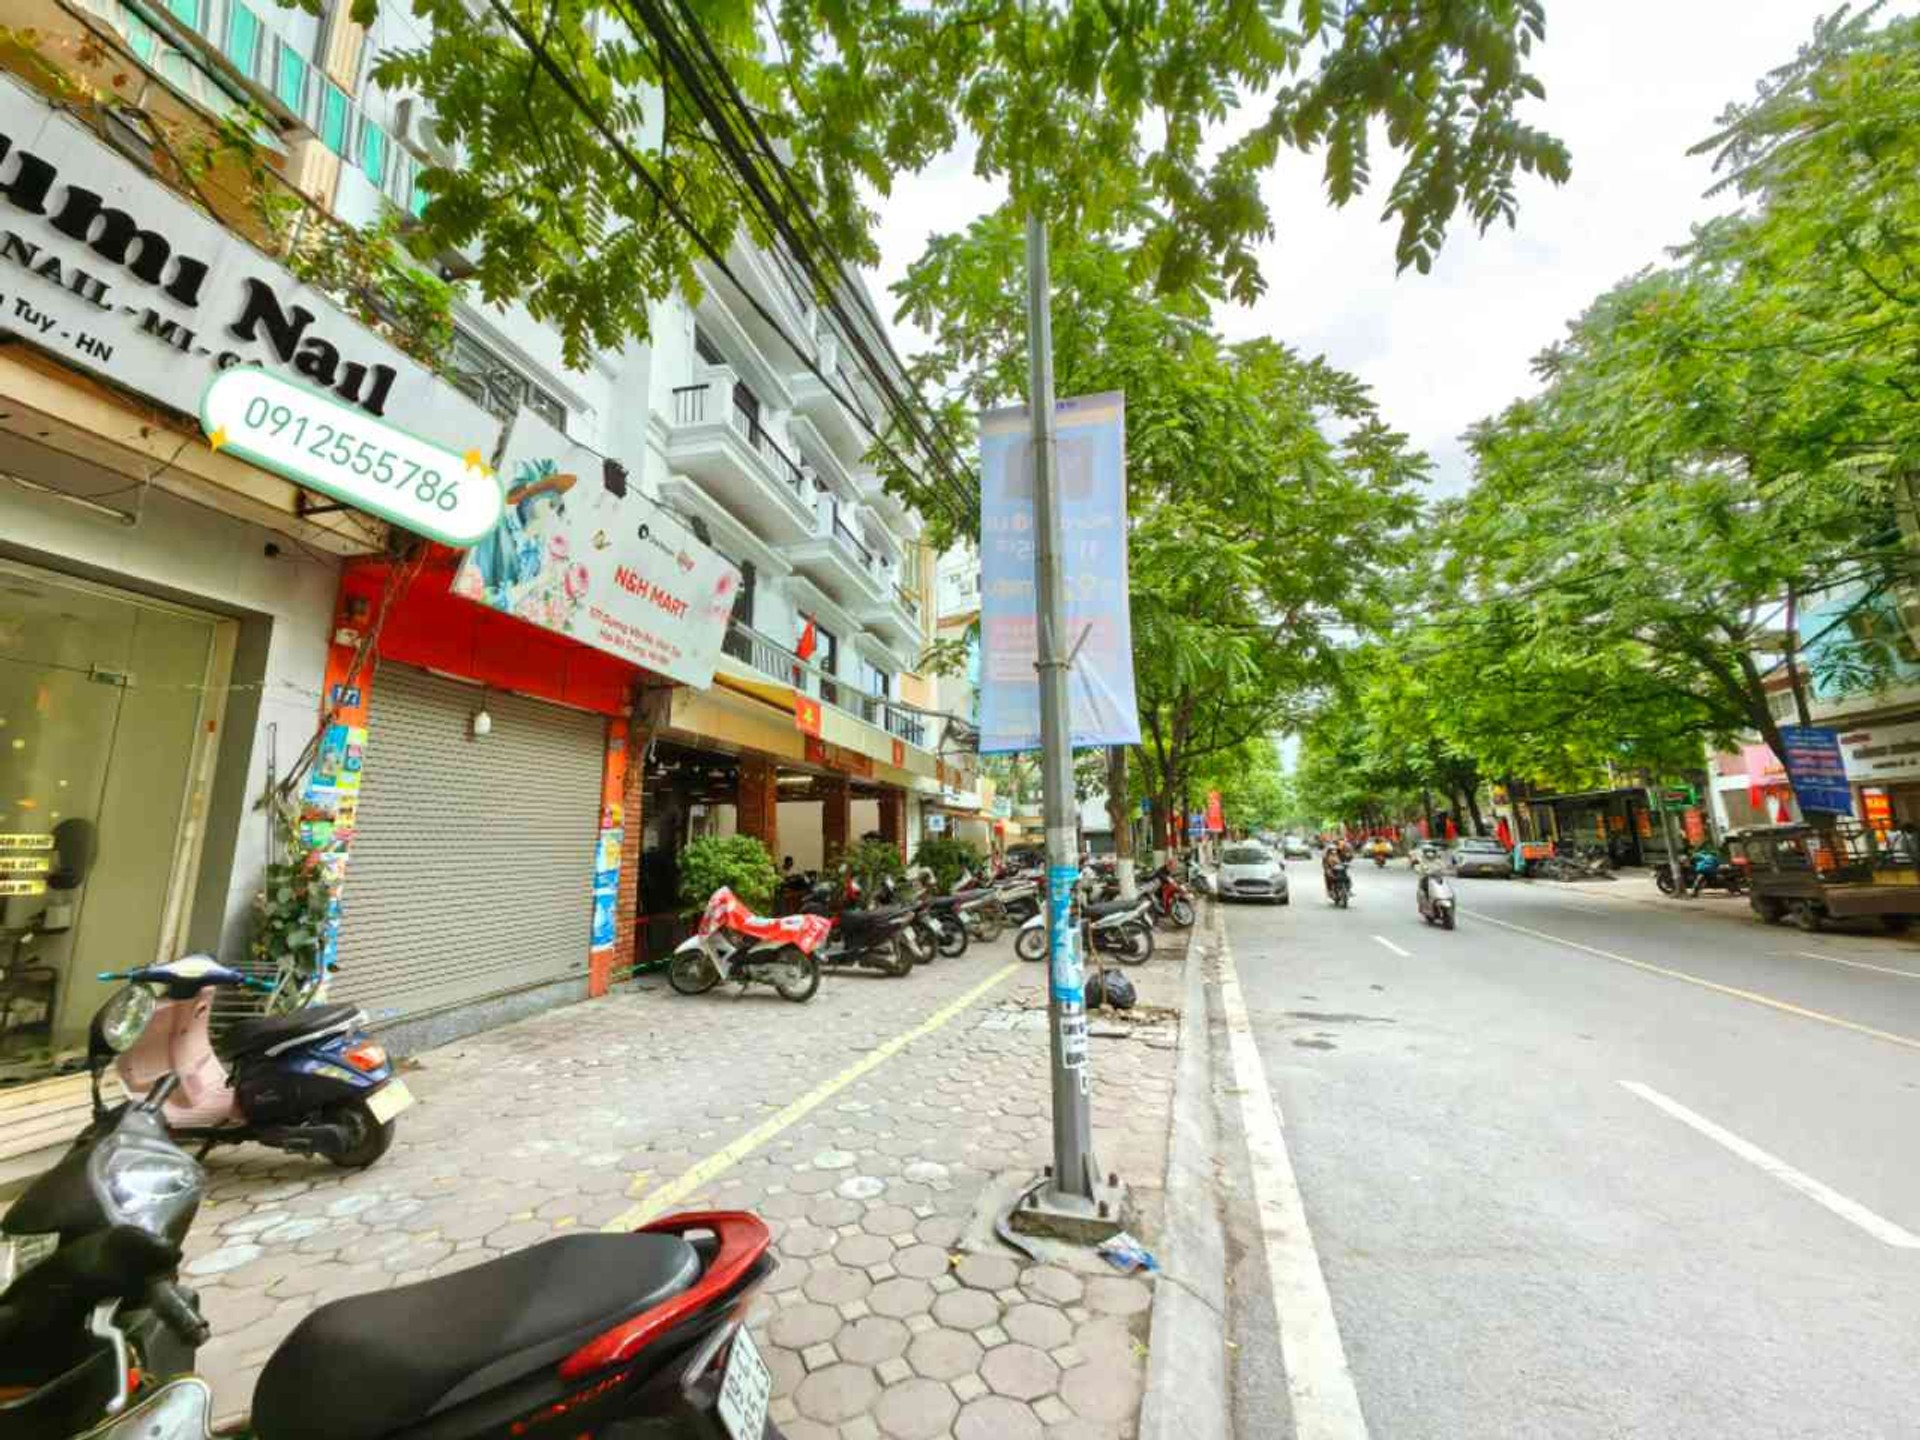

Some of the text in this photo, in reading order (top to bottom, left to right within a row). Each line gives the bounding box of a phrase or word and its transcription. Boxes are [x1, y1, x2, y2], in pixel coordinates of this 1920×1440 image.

[75, 332, 114, 363] HN
[229, 277, 397, 417] Nail
[614, 565, 688, 620] N&H MART
